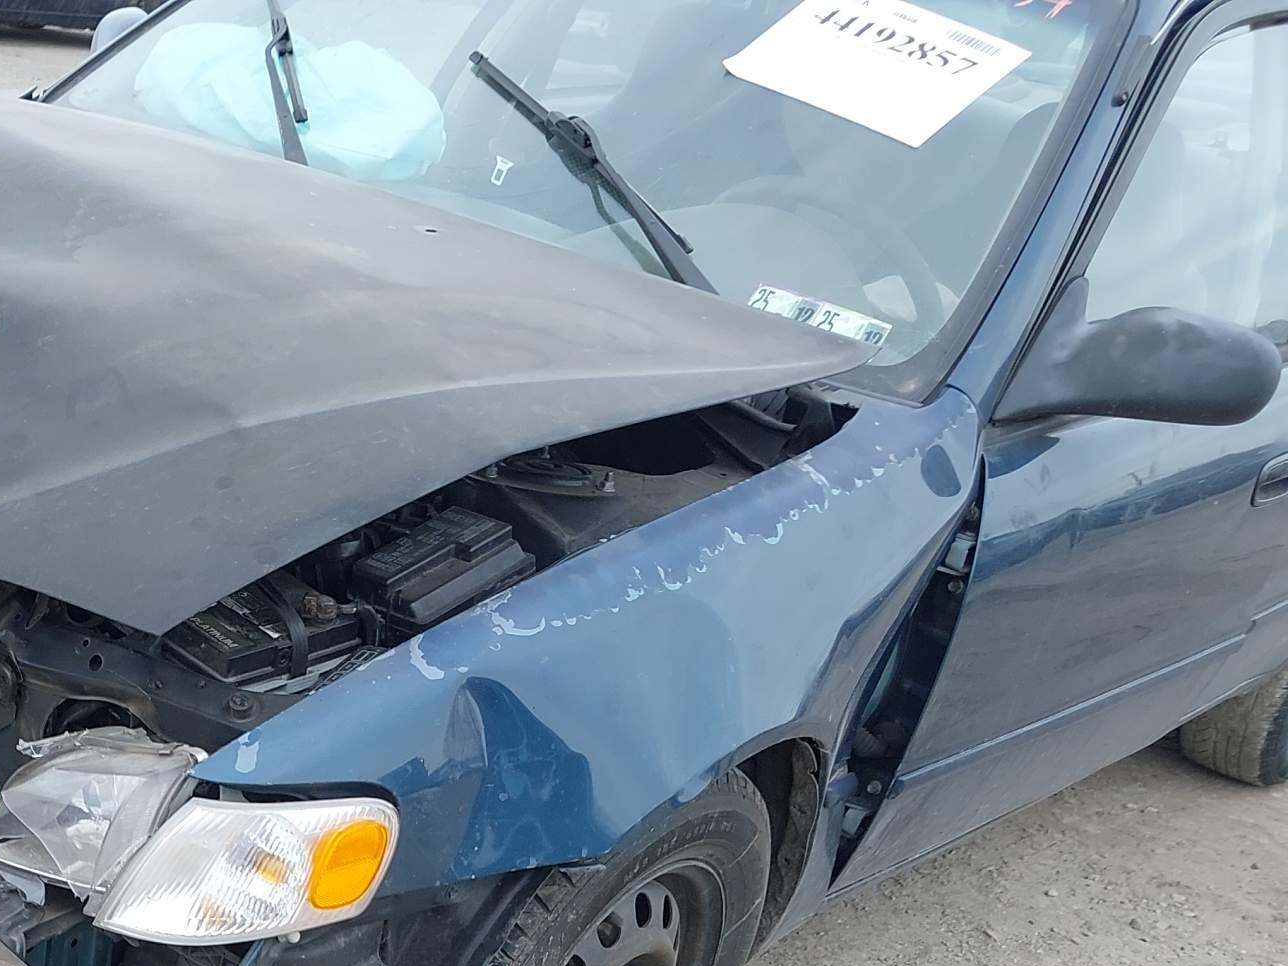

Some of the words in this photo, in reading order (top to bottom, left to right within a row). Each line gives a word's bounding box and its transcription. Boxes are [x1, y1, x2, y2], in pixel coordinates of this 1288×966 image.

[814, 9, 979, 75] 44192857
[750, 288, 776, 311] 25
[816, 310, 840, 332] 25
[189, 616, 239, 649] PLATINUM
